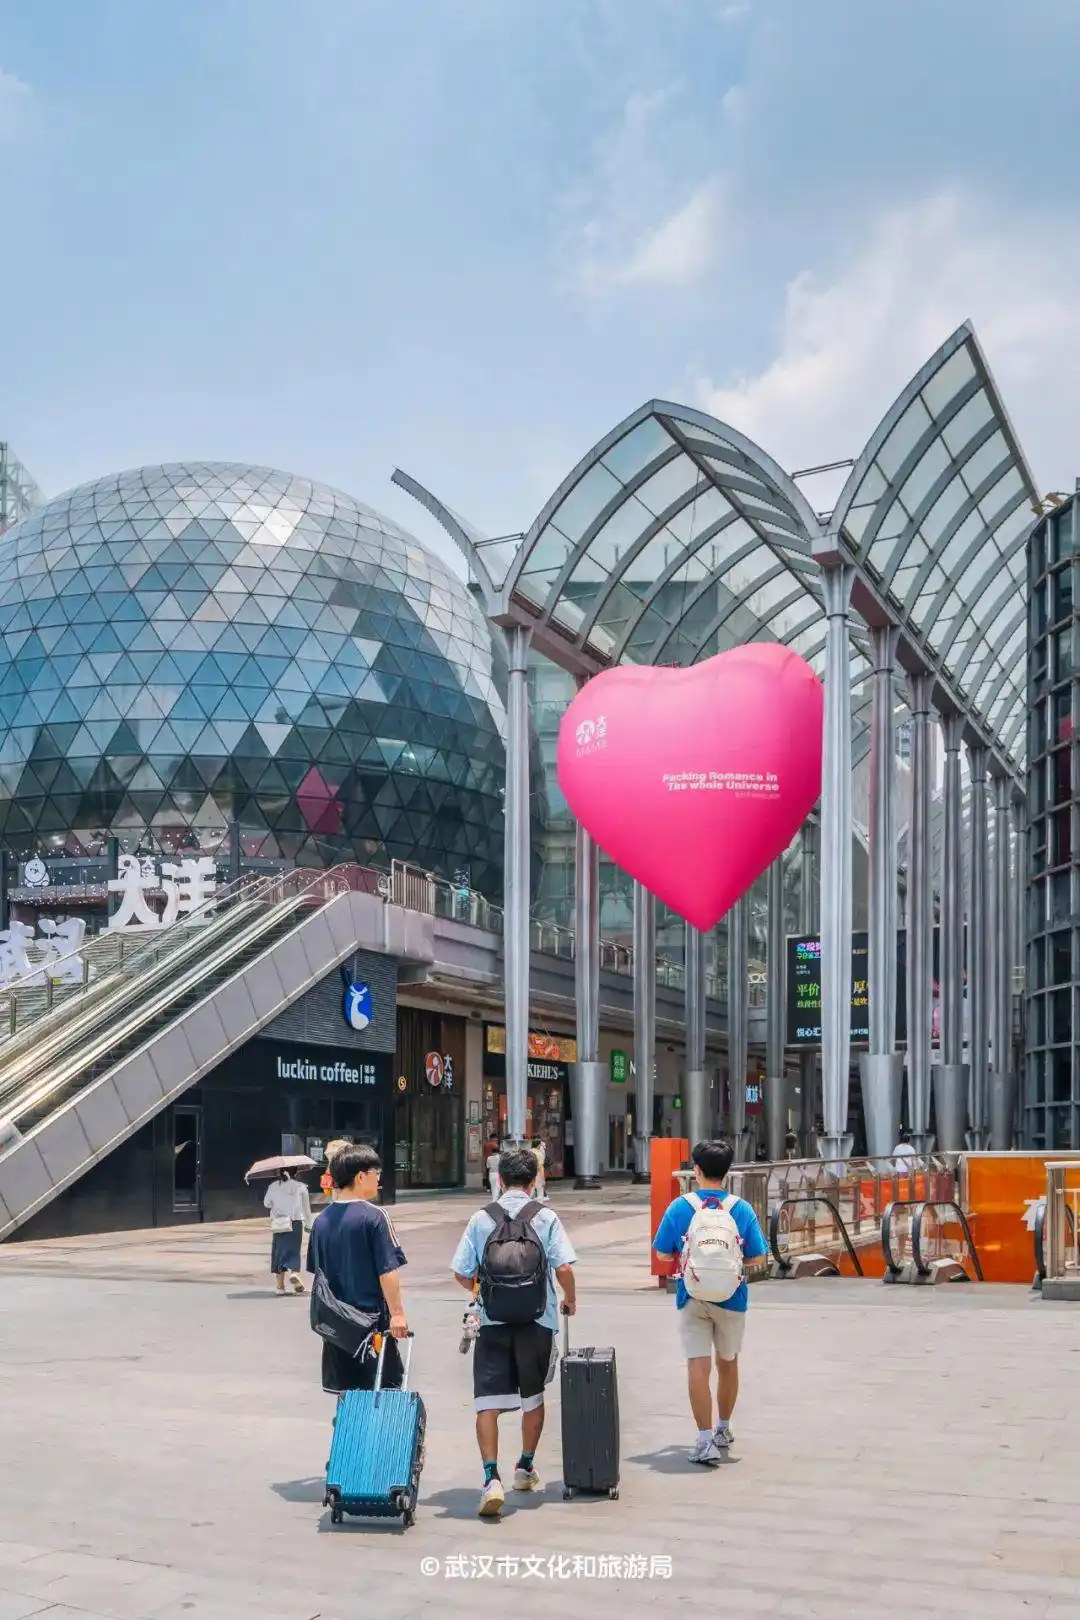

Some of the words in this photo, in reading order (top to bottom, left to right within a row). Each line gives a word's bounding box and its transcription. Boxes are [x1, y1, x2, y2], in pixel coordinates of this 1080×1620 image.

[662, 772, 707, 783] Packing
[709, 772, 763, 781] Romance
[766, 772, 778, 782] in
[668, 782, 688, 791] The
[690, 781, 723, 790] whole
[726, 782, 779, 791] Universe
[853, 980, 869, 994] 厚
[277, 1056, 317, 1080] luckin
[320, 1062, 359, 1083] coffee
[444, 1054, 453, 1089] 大洋
